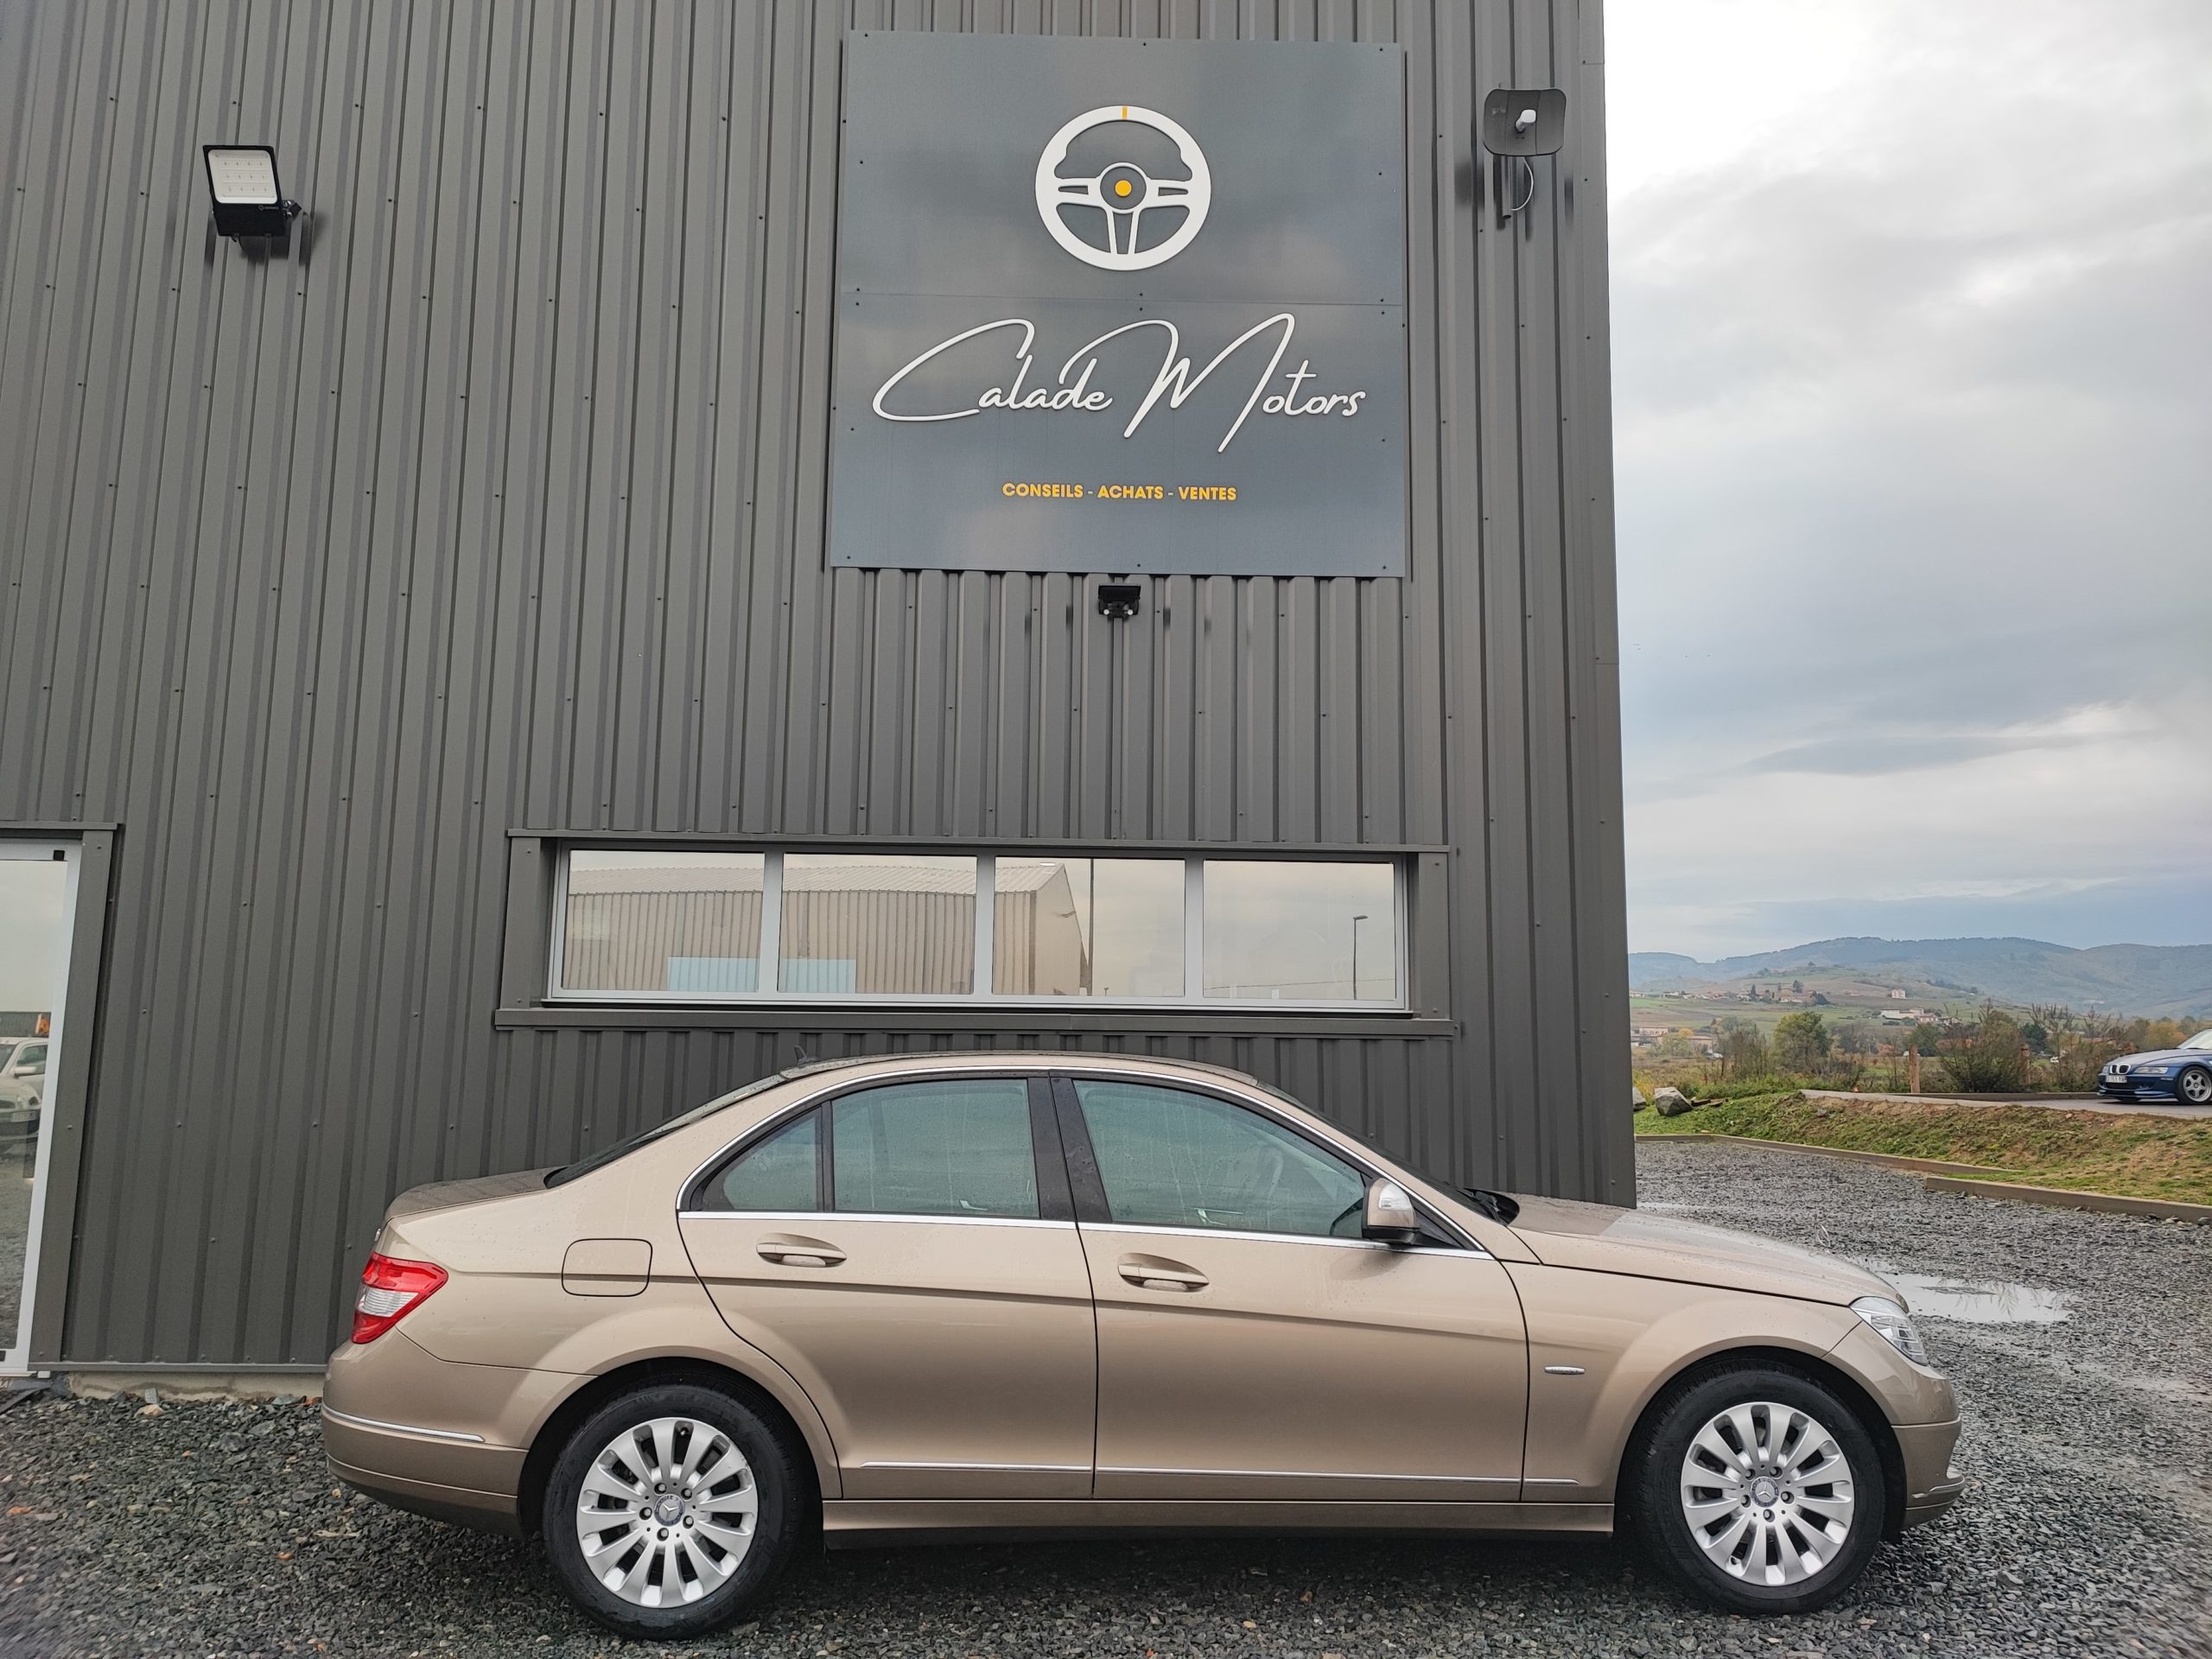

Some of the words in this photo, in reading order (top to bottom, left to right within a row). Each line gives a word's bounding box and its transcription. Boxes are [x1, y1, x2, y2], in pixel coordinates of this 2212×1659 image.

[872, 318, 1113, 422] Calade
[1058, 313, 1367, 453] Motors
[1001, 482, 1084, 498] CONSEILS
[1096, 485, 1164, 499] ACHATS
[1178, 486, 1237, 501] VENTES
